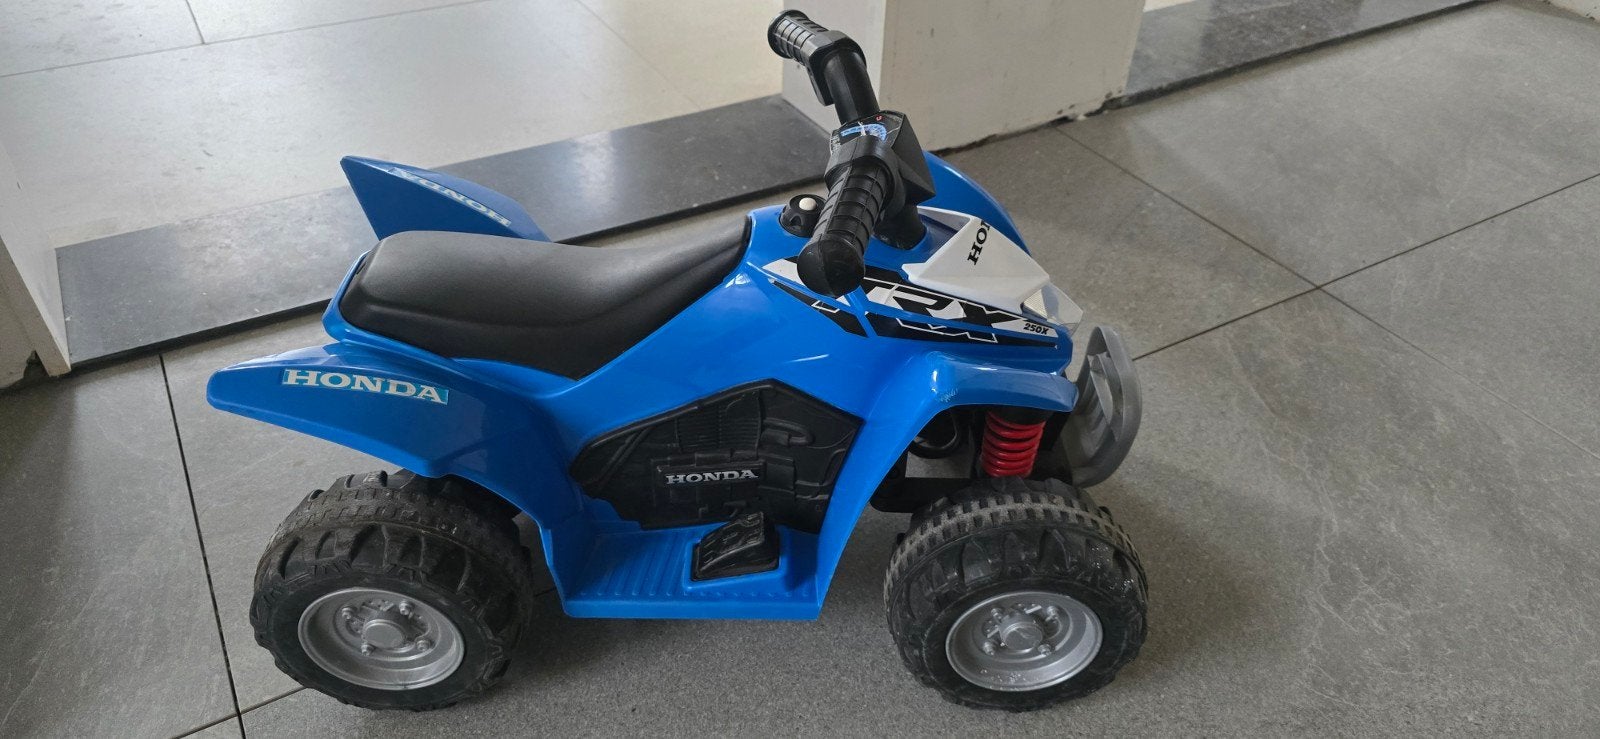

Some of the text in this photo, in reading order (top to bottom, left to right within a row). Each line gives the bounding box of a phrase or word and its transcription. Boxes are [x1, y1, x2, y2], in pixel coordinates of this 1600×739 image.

[392, 167, 511, 226] HONDA
[1023, 322, 1050, 335] 250X
[282, 368, 448, 405] HONDA
[665, 469, 759, 485] HONDA
